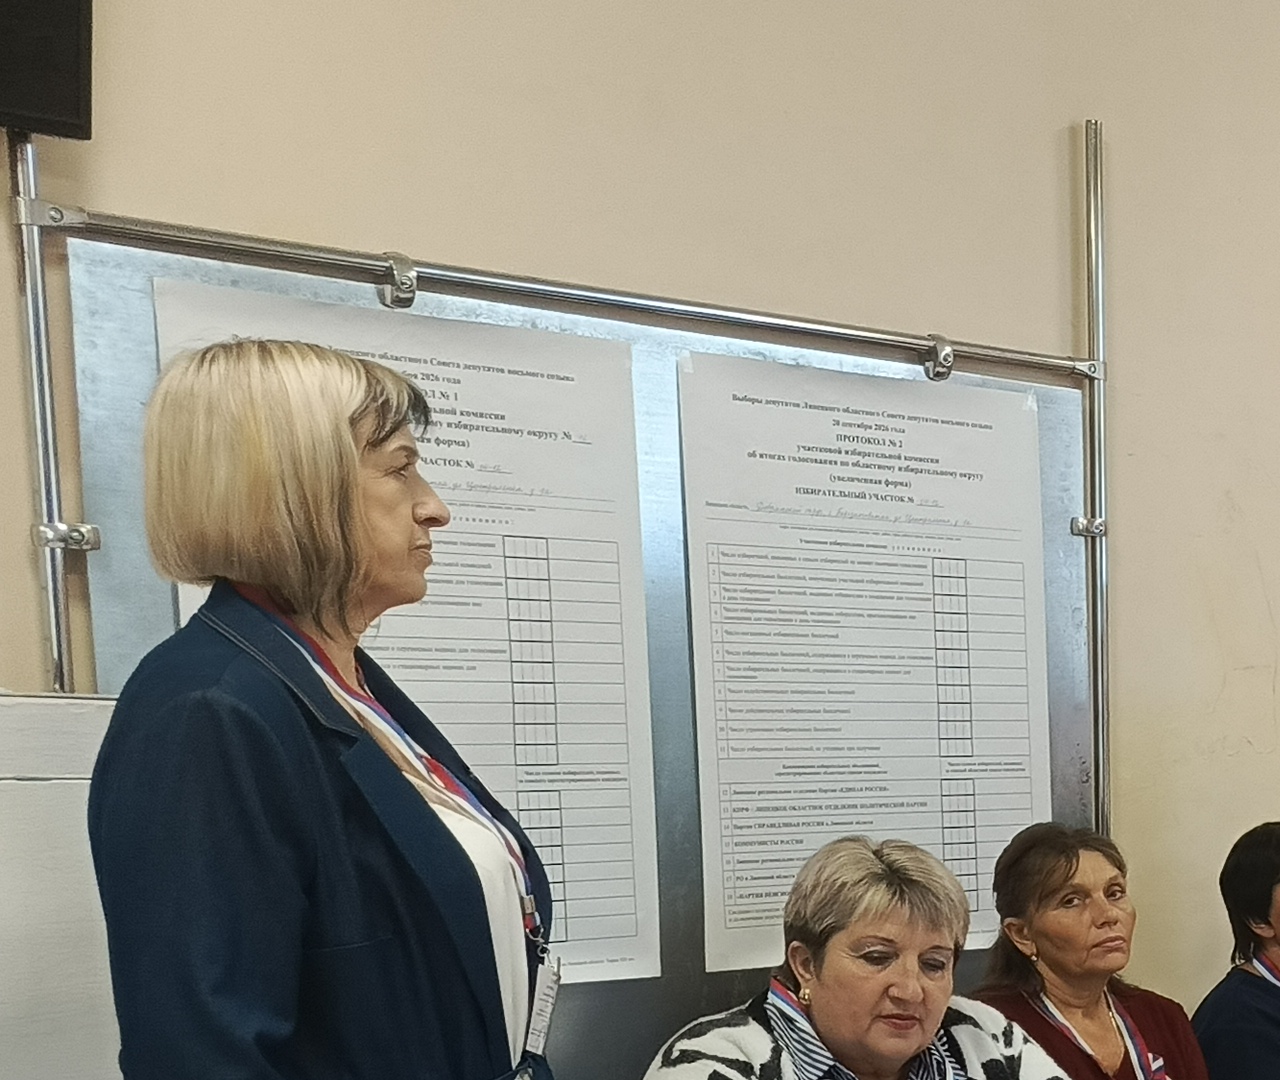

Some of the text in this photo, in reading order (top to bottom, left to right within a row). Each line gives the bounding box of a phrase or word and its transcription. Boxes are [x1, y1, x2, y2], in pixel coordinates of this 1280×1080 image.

[460, 409, 506, 420] комиссии
[447, 420, 524, 437] избирательному
[527, 429, 558, 440] округу
[434, 435, 470, 448] форма)
[836, 434, 886, 447] ПРОТОКОЛ
[797, 445, 940, 464] участковой избирательной комиссии
[420, 456, 462, 468] ЧАСТОК
[747, 450, 757, 458] об
[788, 455, 838, 466] голосования
[897, 465, 957, 479] избирательному
[959, 473, 983, 482] округу
[884, 478, 912, 488] форма)
[795, 487, 866, 500] ИЗБИРАТЕЛЬНЫЙ
[868, 493, 906, 502] УЧАСТОК
